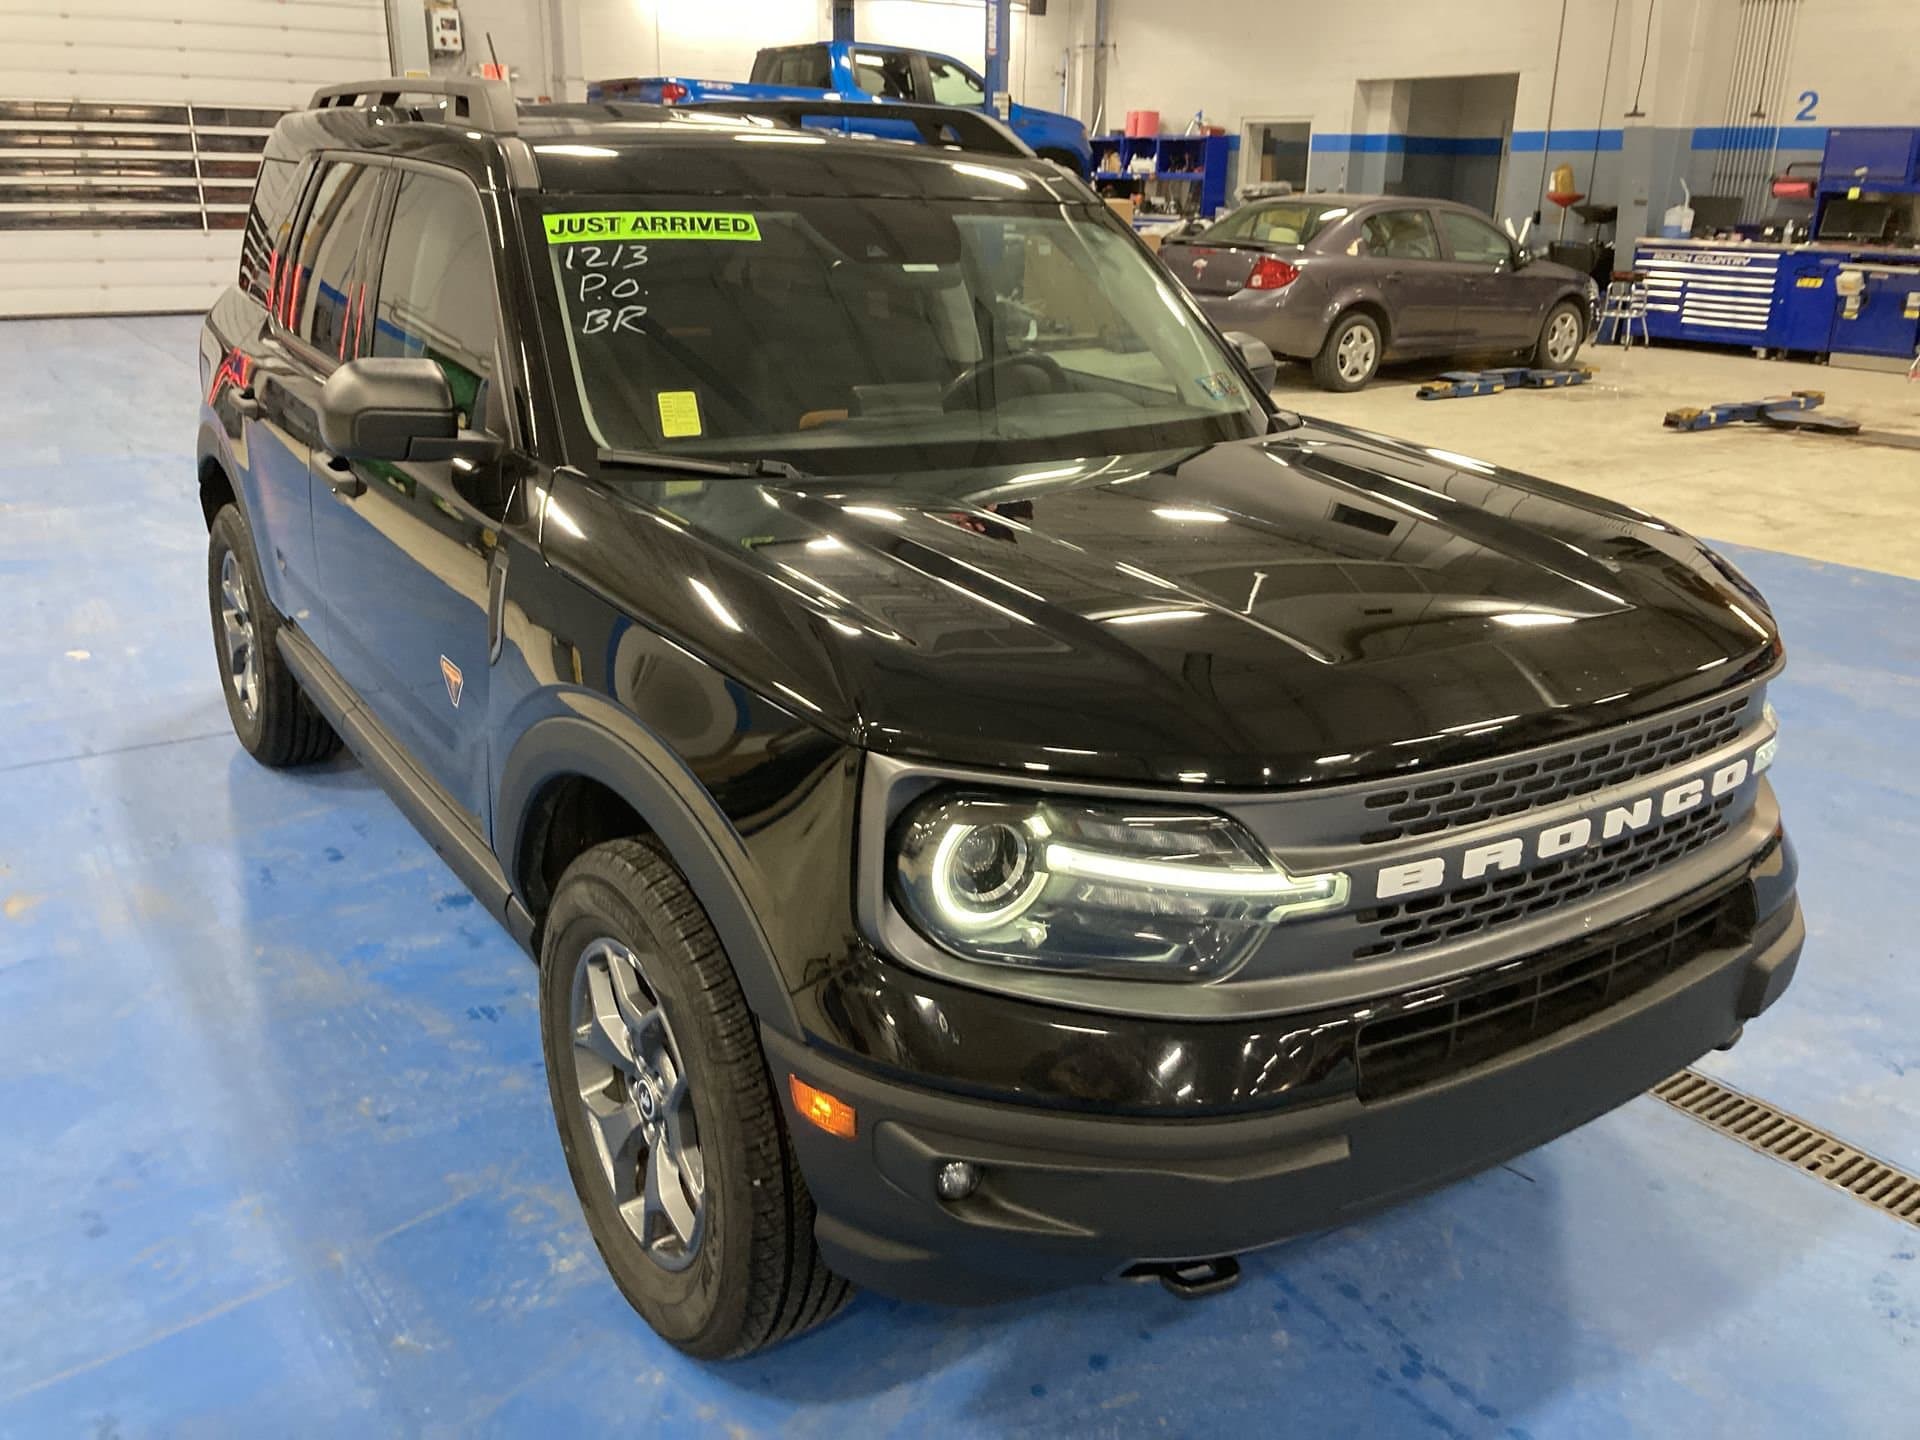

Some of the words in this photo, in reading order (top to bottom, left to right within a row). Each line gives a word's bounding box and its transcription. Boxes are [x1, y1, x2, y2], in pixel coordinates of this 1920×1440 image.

[1795, 91, 1819, 121] 2
[550, 217, 621, 235] JUST
[631, 216, 751, 233] ARRIVED
[1694, 253, 1752, 266] COUNTRY
[582, 305, 648, 334] BR
[1376, 759, 1749, 899] BRONCO
